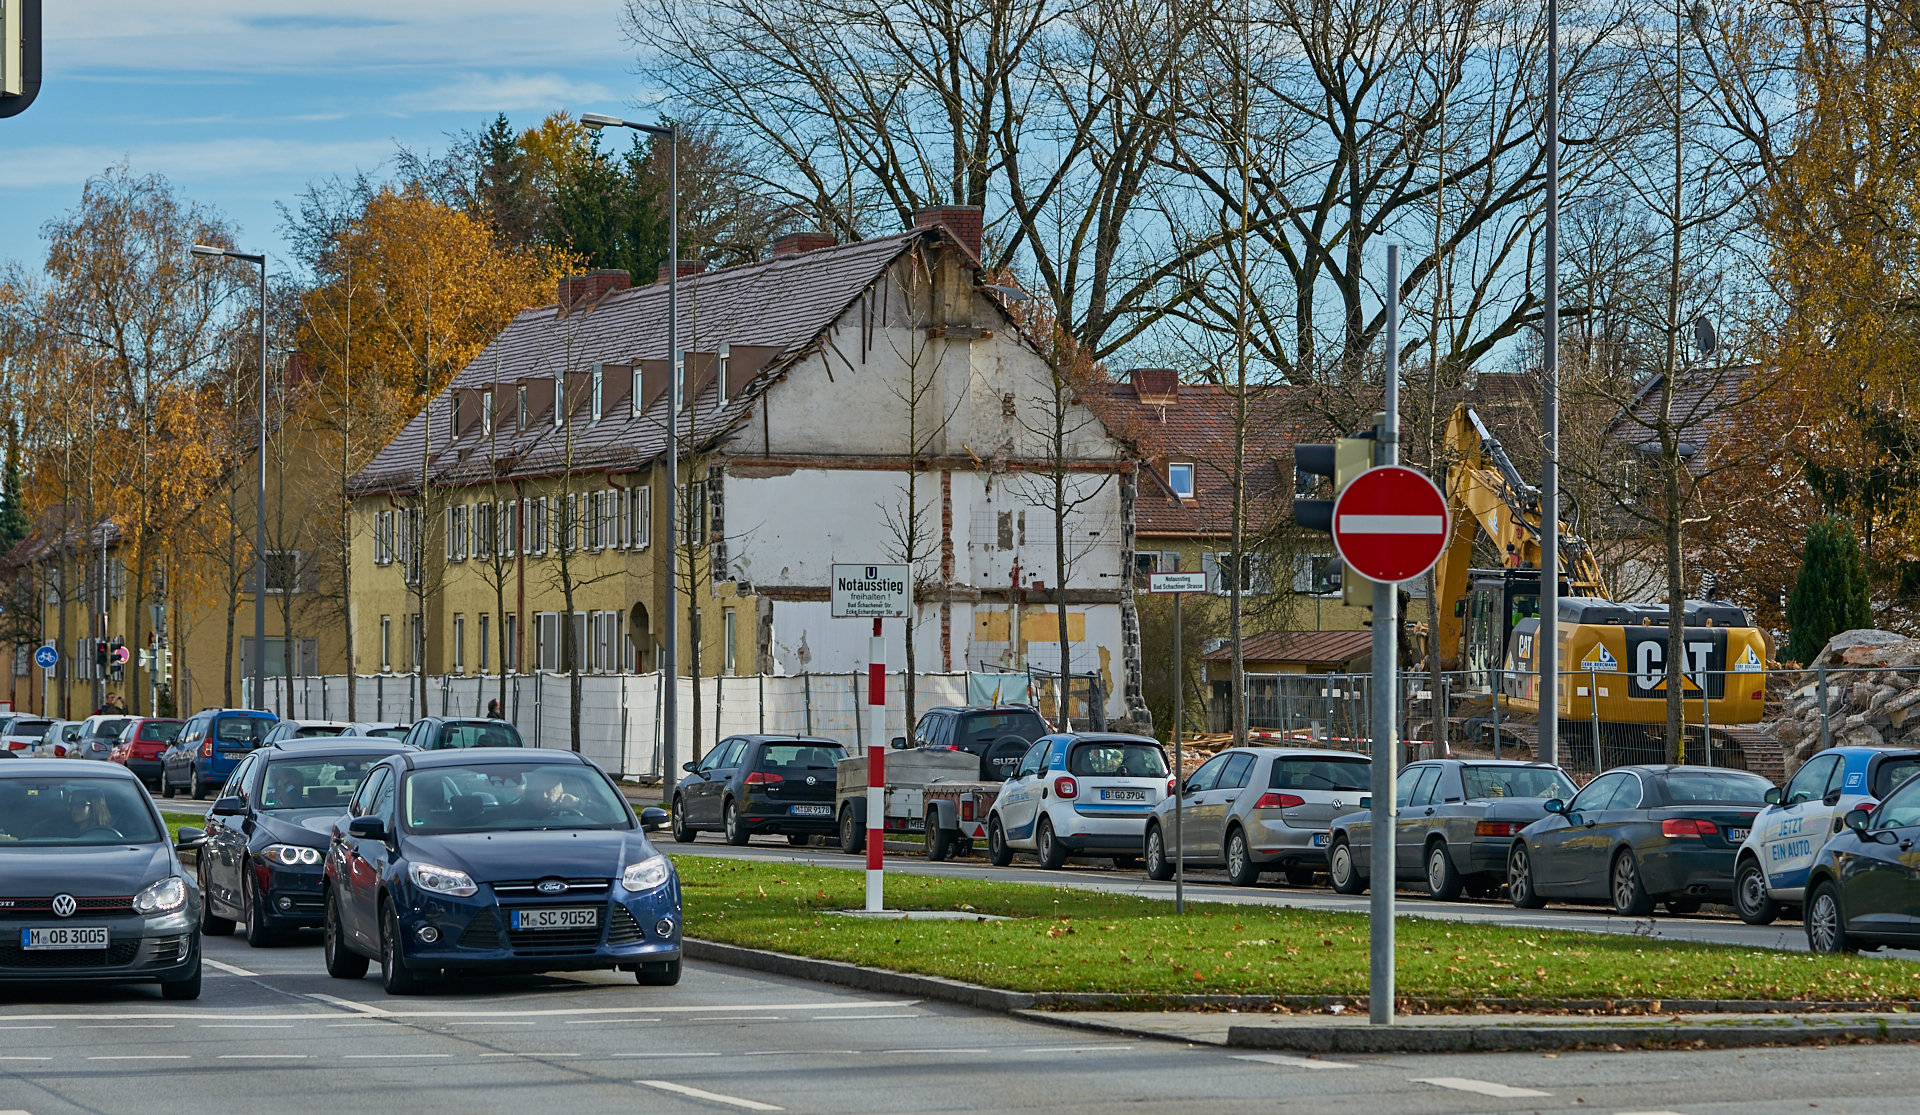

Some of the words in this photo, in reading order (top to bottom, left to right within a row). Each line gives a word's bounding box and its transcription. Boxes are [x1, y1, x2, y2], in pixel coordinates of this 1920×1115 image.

[867, 567, 876, 579] U
[838, 577, 904, 595] Notausstieg
[850, 592, 886, 601] freihalten
[1518, 634, 1533, 659] CAT
[1105, 791, 1111, 799] B
[1115, 791, 1125, 799] GO
[1126, 791, 1145, 800] 3704
[795, 806, 801, 814] M
[813, 806, 831, 815] 9178
[1778, 817, 1804, 837] JETZT
[1772, 843, 1788, 861] EIN
[1788, 839, 1813, 859] AUTO.
[544, 882, 560, 890] Ford
[520, 912, 530, 926] M
[539, 911, 557, 926] SC
[560, 910, 595, 925] 9052
[30, 930, 40, 944] M
[49, 930, 68, 944] OB
[70, 929, 106, 943] 3005
